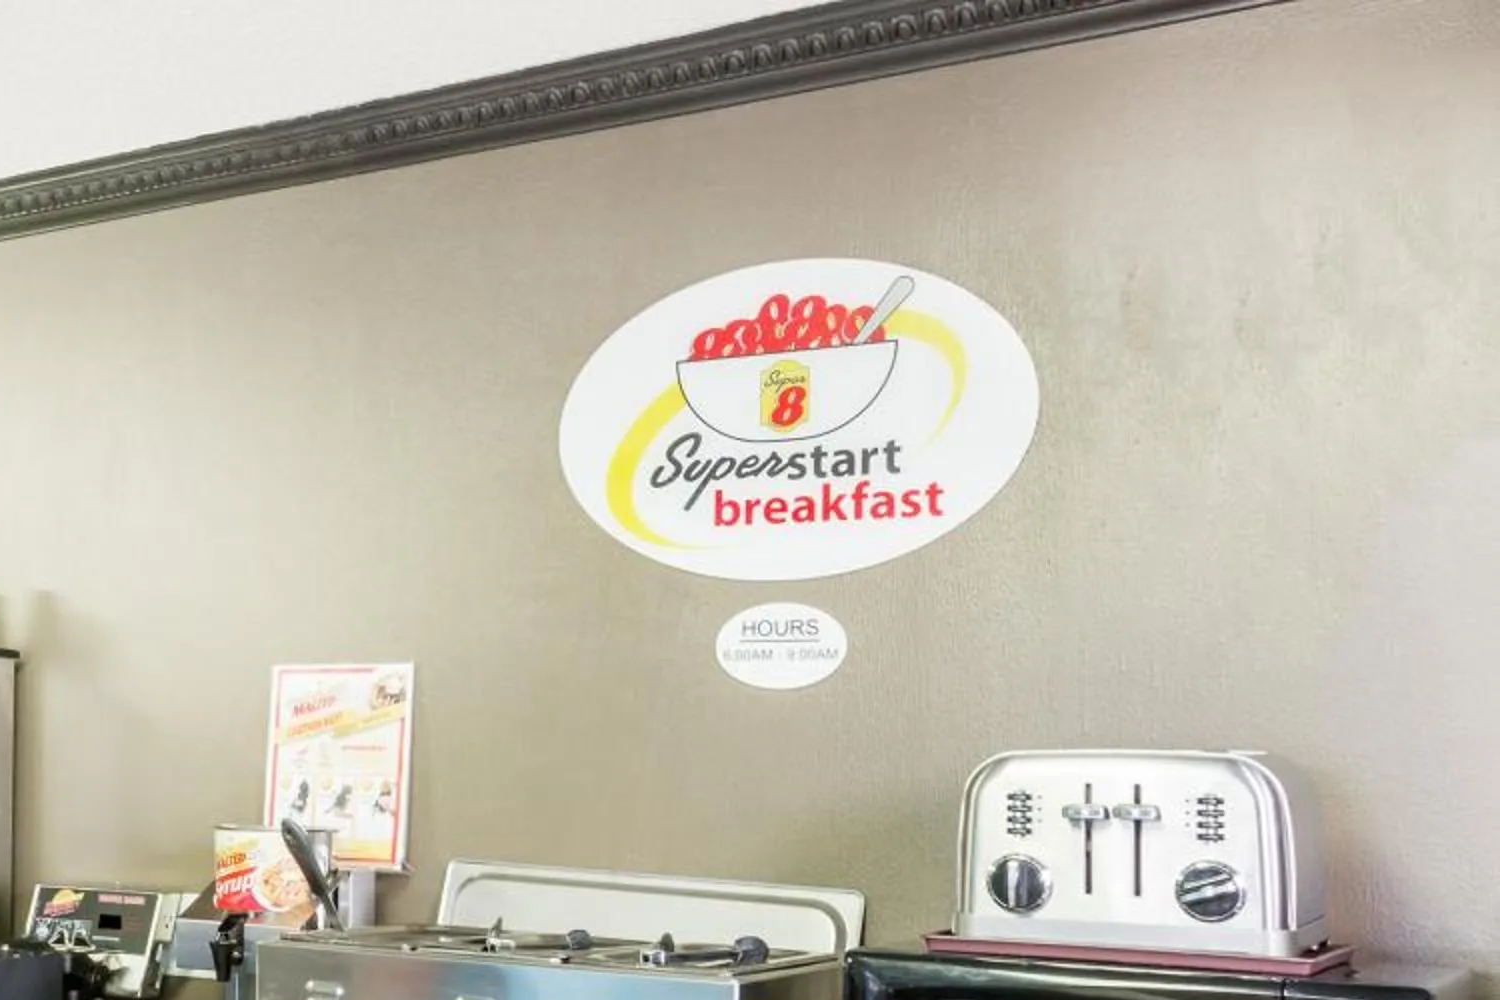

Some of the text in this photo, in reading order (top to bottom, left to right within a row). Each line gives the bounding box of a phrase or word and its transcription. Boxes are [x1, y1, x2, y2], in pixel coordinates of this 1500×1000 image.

[771, 386, 806, 427] 8
[650, 432, 901, 511] Superstart
[713, 480, 945, 526] breakfast
[741, 618, 820, 637] HOURS
